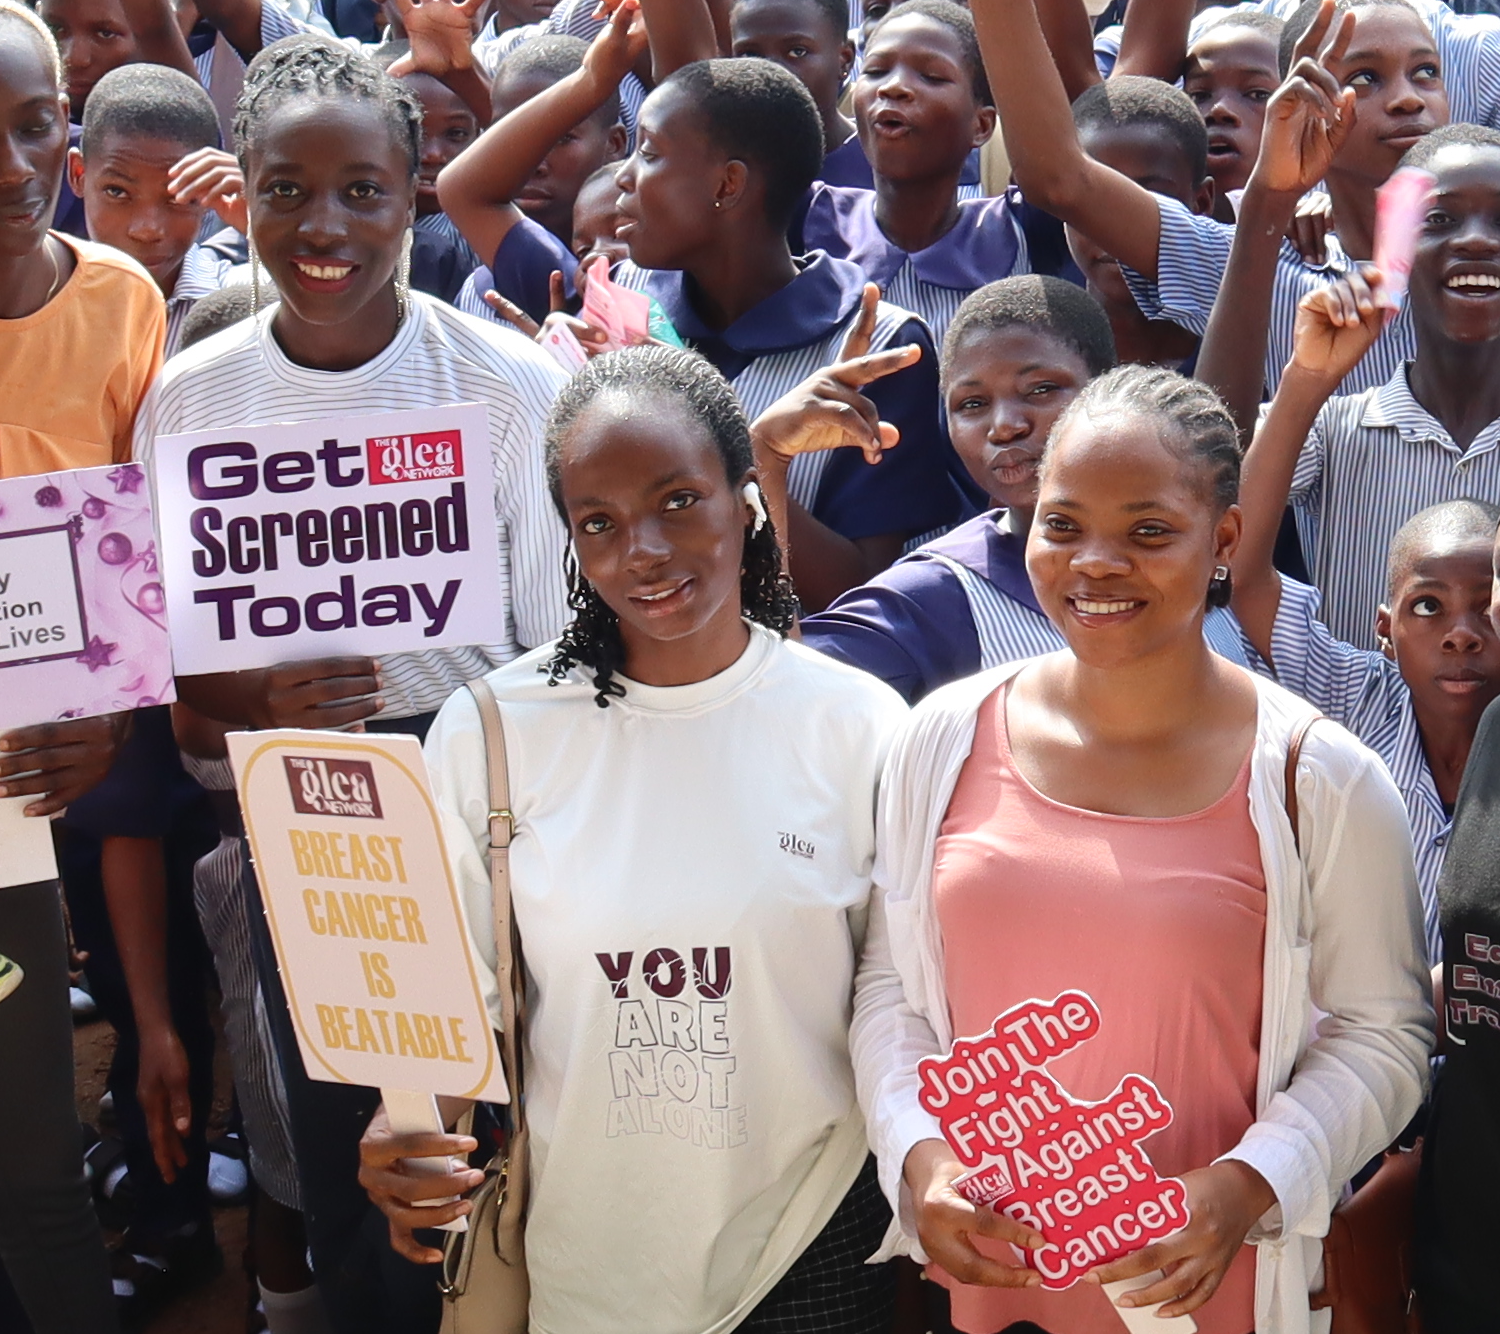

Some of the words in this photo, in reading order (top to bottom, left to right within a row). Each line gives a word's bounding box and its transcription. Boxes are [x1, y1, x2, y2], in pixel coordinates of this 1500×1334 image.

[187, 438, 365, 501] Get
[375, 438, 390, 448] THE
[381, 436, 455, 481] glea
[402, 464, 456, 479] NETWORK
[190, 481, 470, 578] Screened
[193, 574, 463, 641] Today
[289, 757, 307, 769] THE
[300, 759, 373, 812] glea
[322, 798, 376, 816] NETWORK
[287, 829, 408, 884] BREAST
[302, 888, 428, 945] CANCER
[358, 951, 396, 999] IS
[594, 946, 732, 999] YOU
[315, 1003, 474, 1063] BEATABLE
[615, 999, 730, 1054] ARE
[608, 1049, 736, 1109] NOT
[926, 1045, 1011, 1108] Join
[1004, 1002, 1090, 1057] The
[605, 1096, 748, 1149] ALONE
[949, 1079, 1061, 1158] Fight
[1012, 1086, 1162, 1188] Against
[1002, 1148, 1147, 1233] Breast
[1032, 1188, 1179, 1279] Cancer
